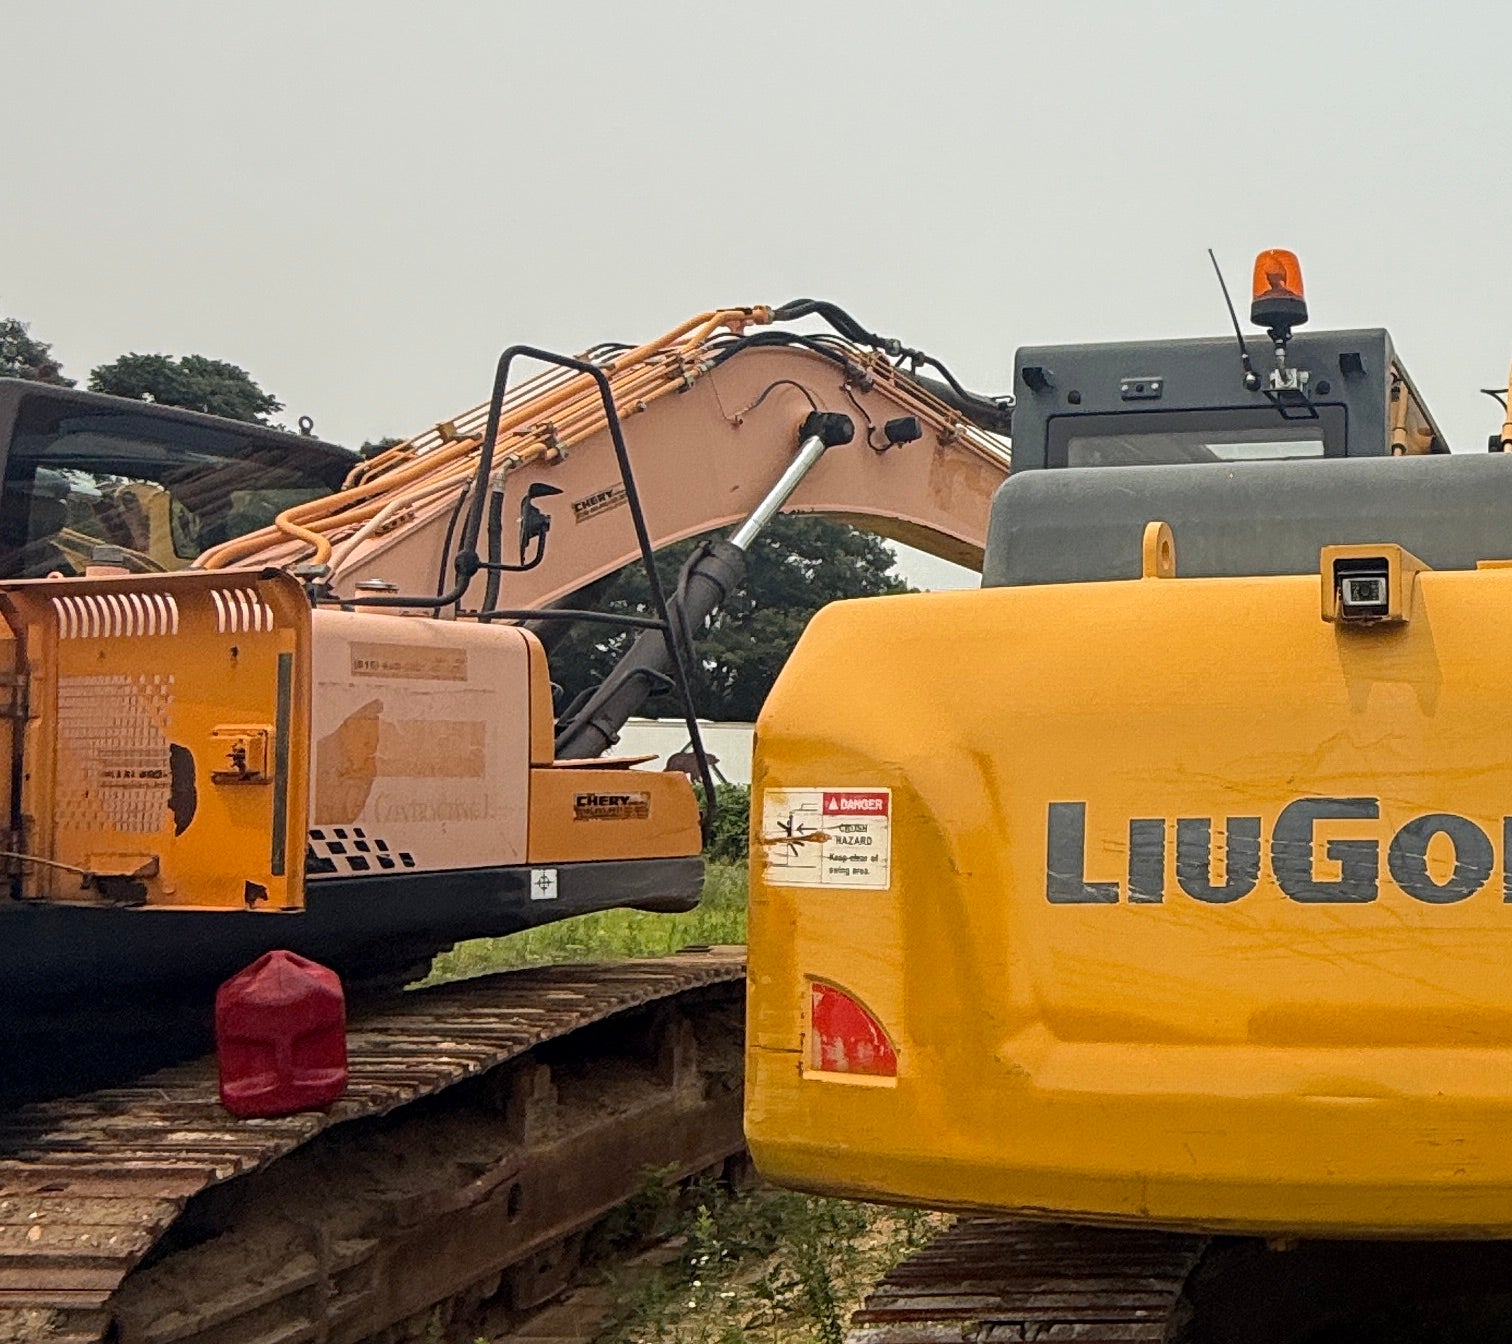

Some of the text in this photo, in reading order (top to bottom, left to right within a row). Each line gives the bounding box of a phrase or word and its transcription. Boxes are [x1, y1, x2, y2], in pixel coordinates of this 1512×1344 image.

[576, 795, 630, 807] CHERY
[840, 798, 883, 811] DANGER
[839, 823, 868, 833] CRUSH
[835, 835, 873, 845] HAZARD
[829, 853, 848, 863] Keep
[870, 853, 879, 863] of
[829, 866, 849, 876] swing
